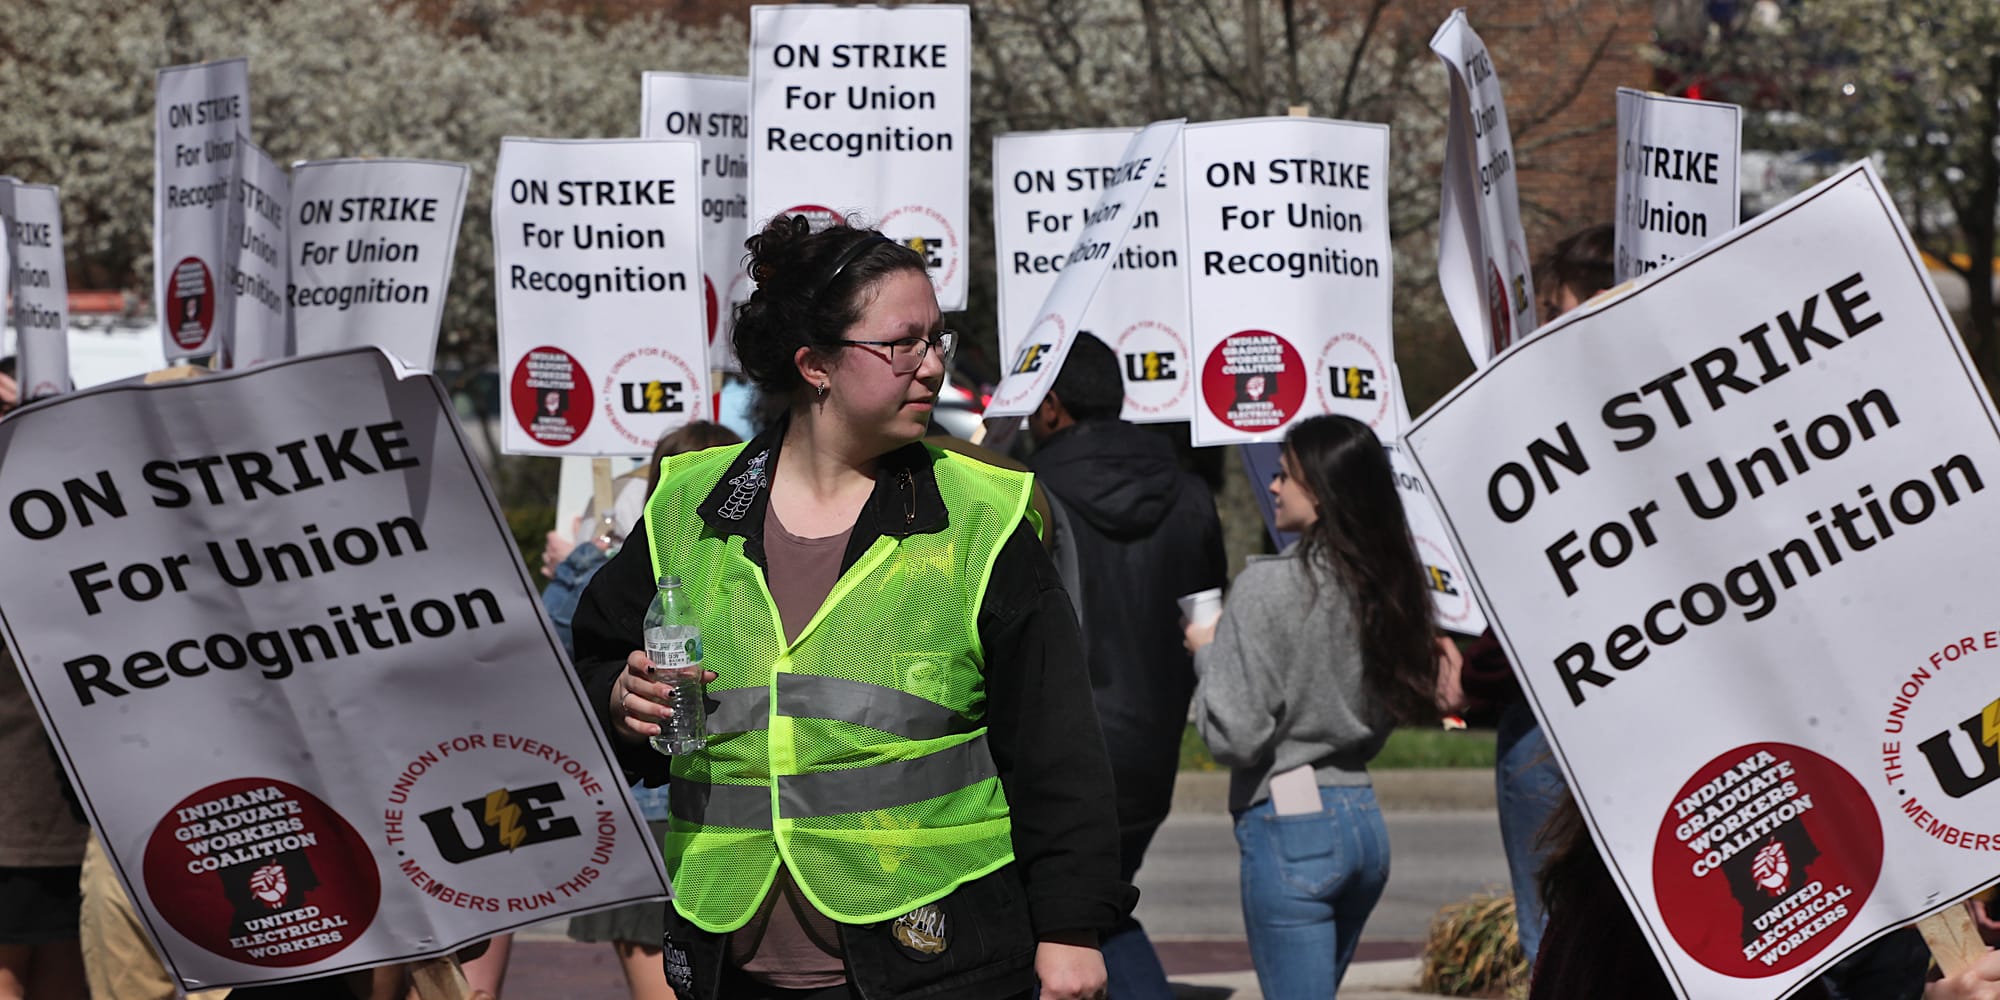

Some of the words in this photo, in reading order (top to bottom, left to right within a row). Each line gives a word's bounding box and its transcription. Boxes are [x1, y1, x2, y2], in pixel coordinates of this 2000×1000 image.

[773, 43, 819, 69] ON
[832, 43, 948, 69] STRIKE
[169, 102, 193, 129] ON
[197, 95, 240, 125] STRIKE
[785, 84, 837, 110] For
[847, 84, 936, 110] Union
[666, 111, 702, 136] ON
[707, 113, 749, 139] STRI
[766, 126, 953, 158] Recognition
[176, 143, 201, 169] For
[715, 153, 749, 179] Uni
[510, 178, 549, 205] ON
[558, 179, 676, 207] STRIKE
[1013, 170, 1055, 195] ON
[1205, 161, 1256, 188] ON
[1268, 159, 1370, 190] STRIKE
[300, 199, 334, 226] ON
[338, 197, 438, 223] STRIKE
[1026, 209, 1074, 234] For
[1220, 205, 1277, 232] For
[1286, 202, 1364, 234] Union
[1637, 198, 1708, 239] Union
[301, 241, 340, 267] For
[346, 236, 420, 265] Union
[522, 221, 565, 248] For
[573, 223, 666, 250] Union
[1203, 246, 1380, 279] Recognition
[286, 277, 430, 312] Recognition
[510, 264, 687, 300] Recognition
[1125, 350, 1177, 383] UE
[1328, 366, 1377, 402] UE
[619, 380, 684, 414] UE
[1487, 421, 1591, 524] ON
[1600, 271, 1884, 453] STRIKE
[9, 469, 129, 541] ON
[141, 420, 421, 509] STRIKE
[1544, 500, 1661, 598] For
[1674, 387, 1901, 521] Union
[69, 552, 192, 617] For
[204, 515, 430, 588] Union
[1552, 453, 1986, 708] Recognition
[63, 586, 506, 707] Recognition
[1928, 635, 1979, 671] FOR
[1884, 666, 1933, 735] UNION
[436, 733, 487, 758] FOR
[1882, 741, 1905, 786] THE
[388, 750, 439, 805] UNION
[492, 733, 603, 797] EVERYONE
[1674, 750, 1777, 820] INDIANA
[1675, 760, 1796, 842] GRADUATE
[174, 799, 303, 843] GRADUATE
[176, 785, 286, 824] INDIANA
[1687, 780, 1799, 855] WORKERS
[186, 816, 305, 857] WORKERS
[384, 808, 405, 847] THE
[418, 781, 583, 865] UE
[1692, 793, 1814, 878] COALITION
[187, 832, 318, 876] COALITION
[399, 858, 501, 913] MEMBERS
[506, 890, 557, 913] RUN
[555, 865, 601, 898] THIS
[590, 809, 617, 866] UNION
[244, 904, 321, 932] UNITED
[1742, 883, 1853, 962] ELECTRICAL
[1752, 880, 1824, 932] UNITED
[229, 913, 349, 949] ELECTRICAL
[247, 930, 344, 960] WORKERS
[1759, 903, 1850, 967] WORKERS
